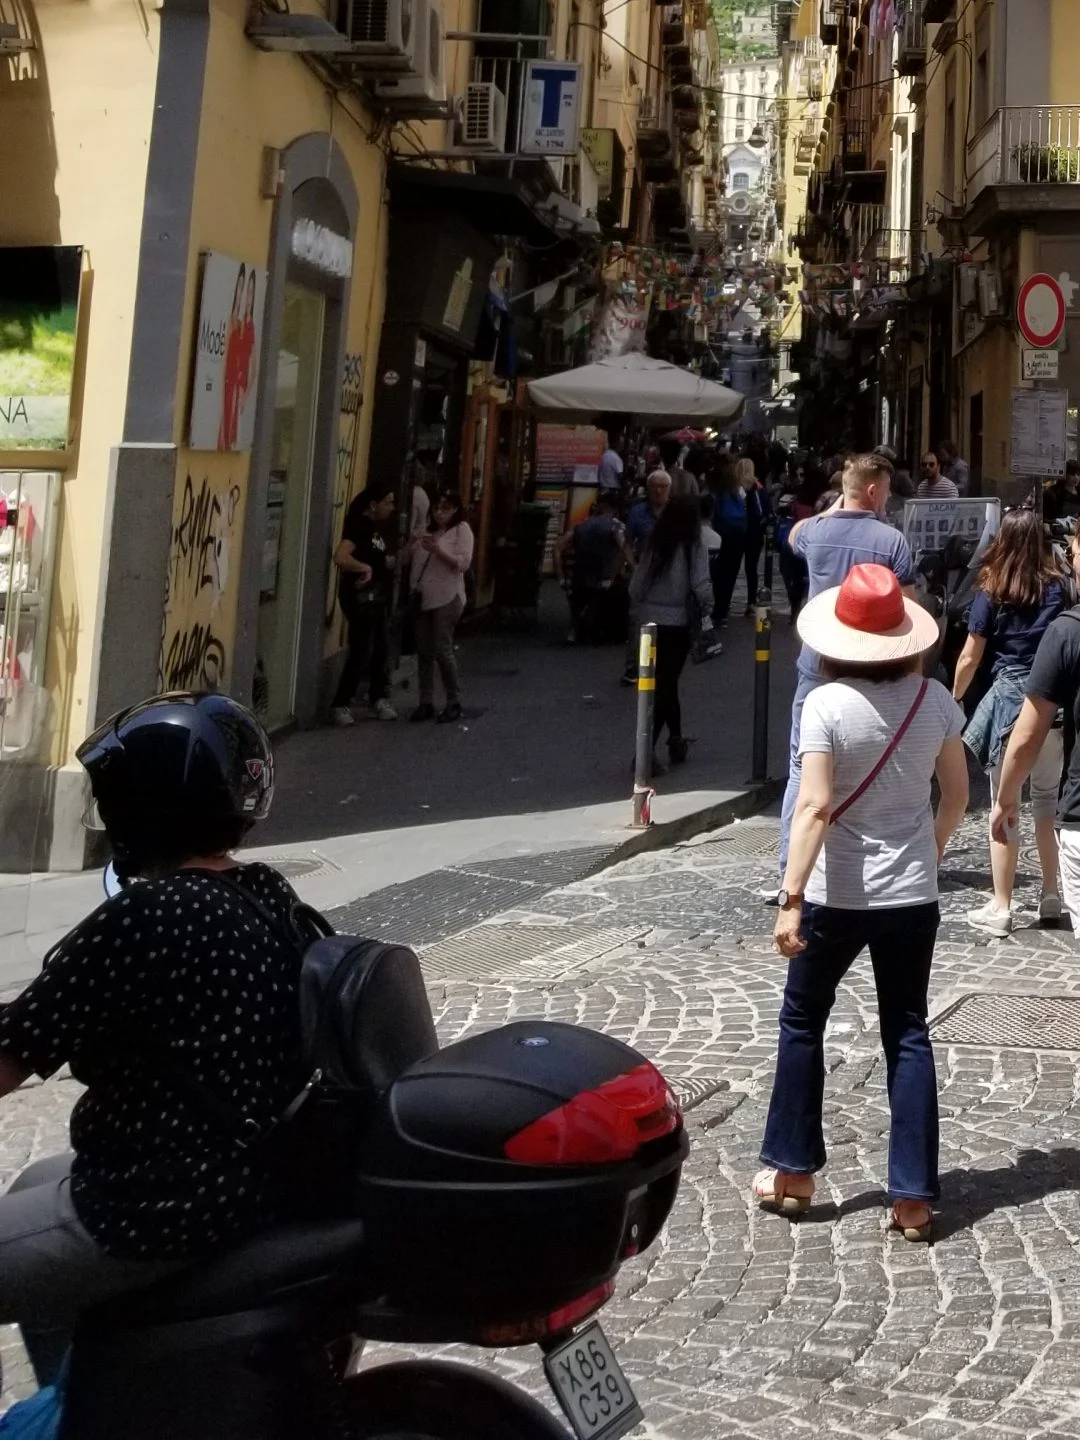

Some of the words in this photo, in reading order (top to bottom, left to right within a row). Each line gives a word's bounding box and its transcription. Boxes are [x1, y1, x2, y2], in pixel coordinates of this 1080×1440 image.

[531, 68, 577, 128] T
[560, 1340, 607, 1393] X86
[579, 1374, 624, 1427] C39
